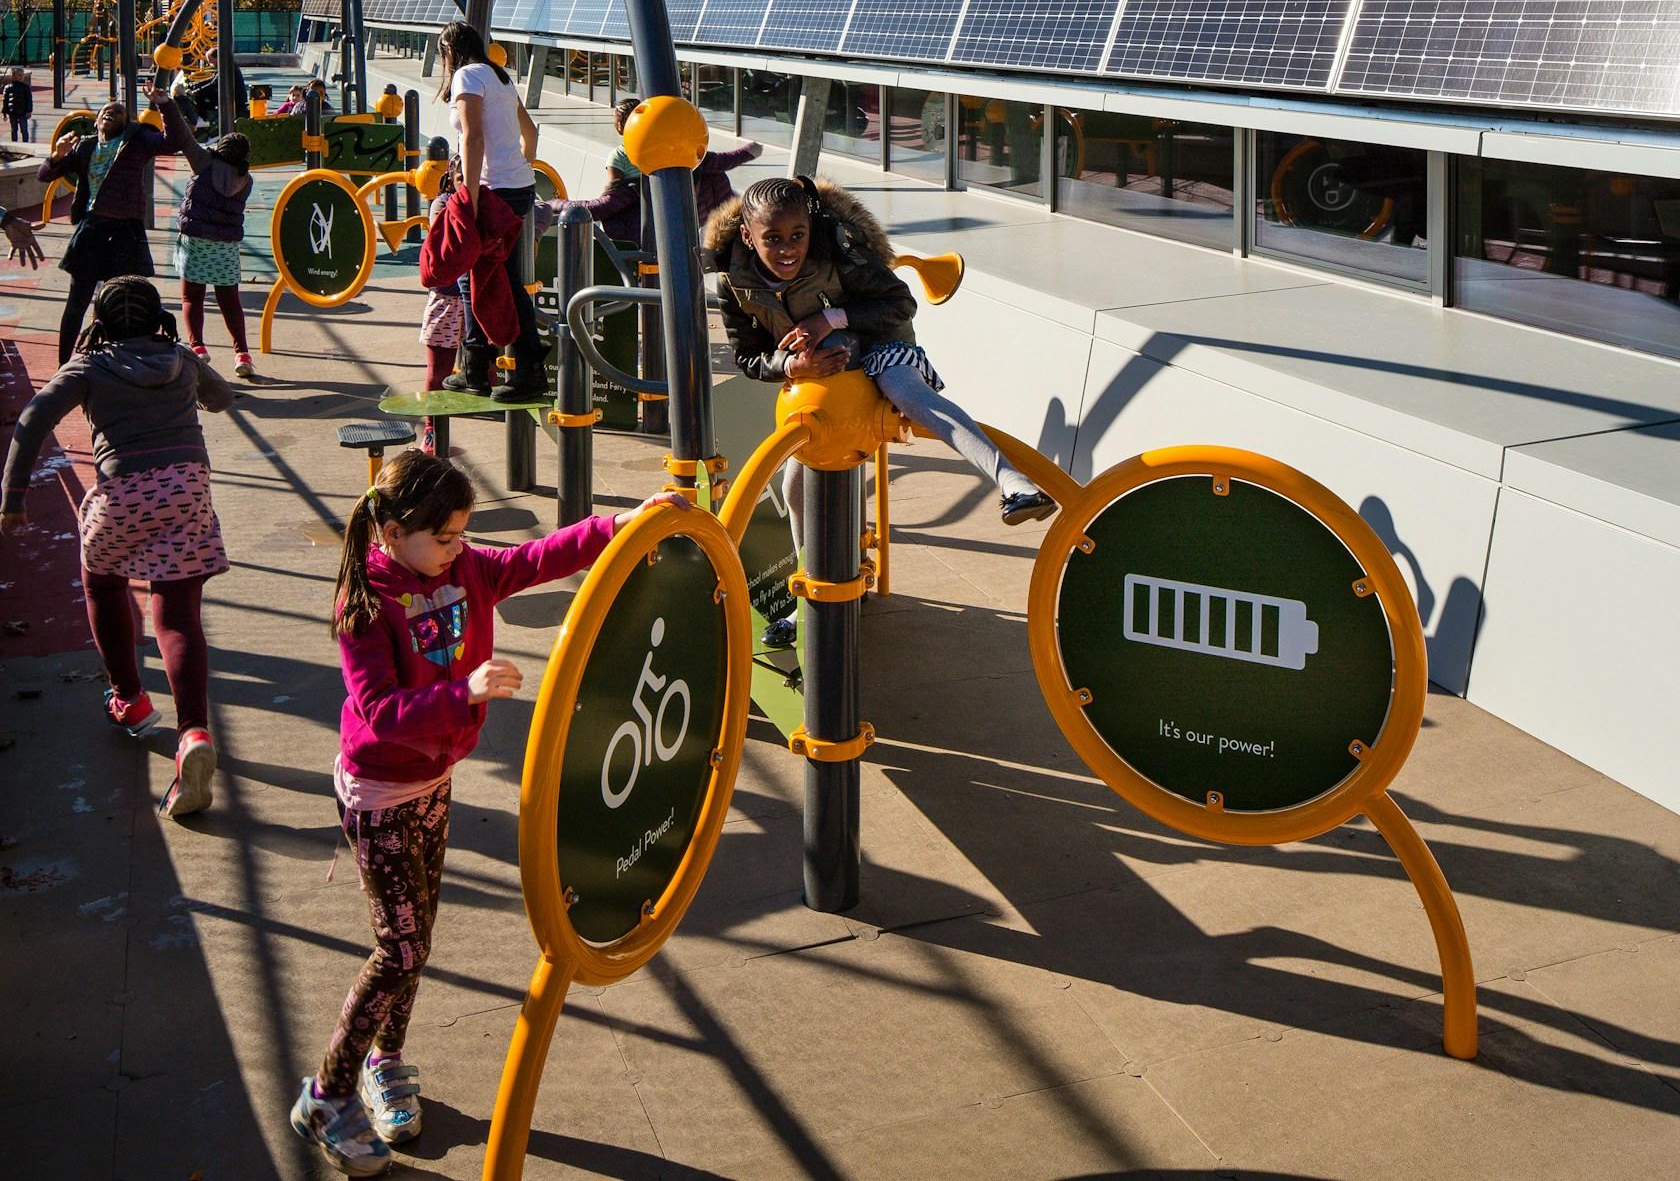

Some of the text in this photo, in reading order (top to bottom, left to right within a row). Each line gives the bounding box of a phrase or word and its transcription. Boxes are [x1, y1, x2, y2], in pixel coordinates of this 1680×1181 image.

[609, 381, 627, 394] Ferry
[762, 563, 778, 580] makes
[1159, 719, 1274, 758] It's our power!
[616, 806, 674, 880] Pedal Power!
